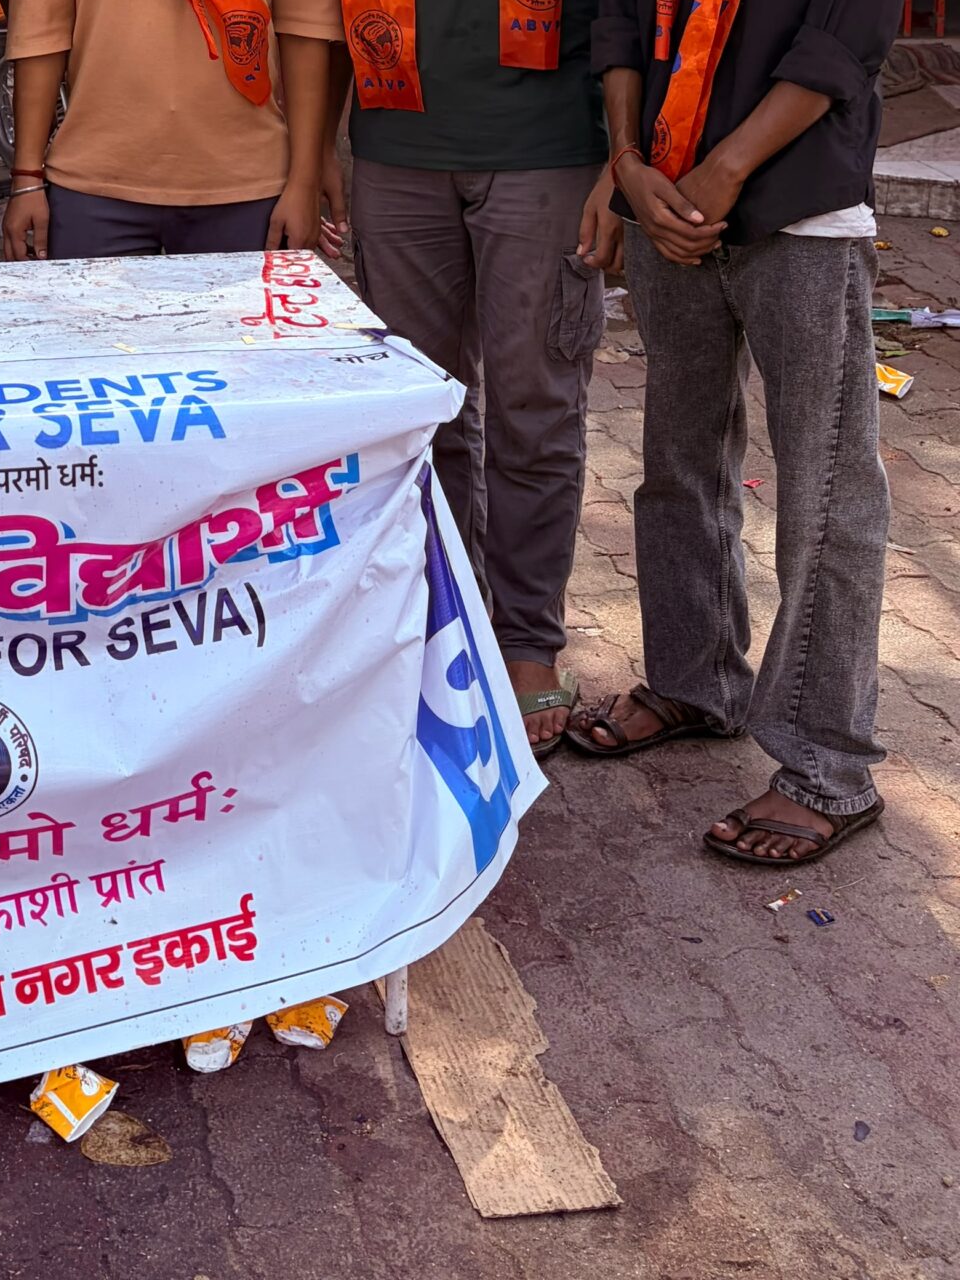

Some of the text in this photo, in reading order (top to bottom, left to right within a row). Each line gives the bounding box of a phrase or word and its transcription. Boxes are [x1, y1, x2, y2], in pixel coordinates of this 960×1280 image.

[32, 395, 227, 449] SEVA
[106, 582, 267, 661] SEVA)
[89, 858, 166, 909] प्रांत
[11, 942, 125, 1007] नगर
[126, 893, 260, 988] इकाई
